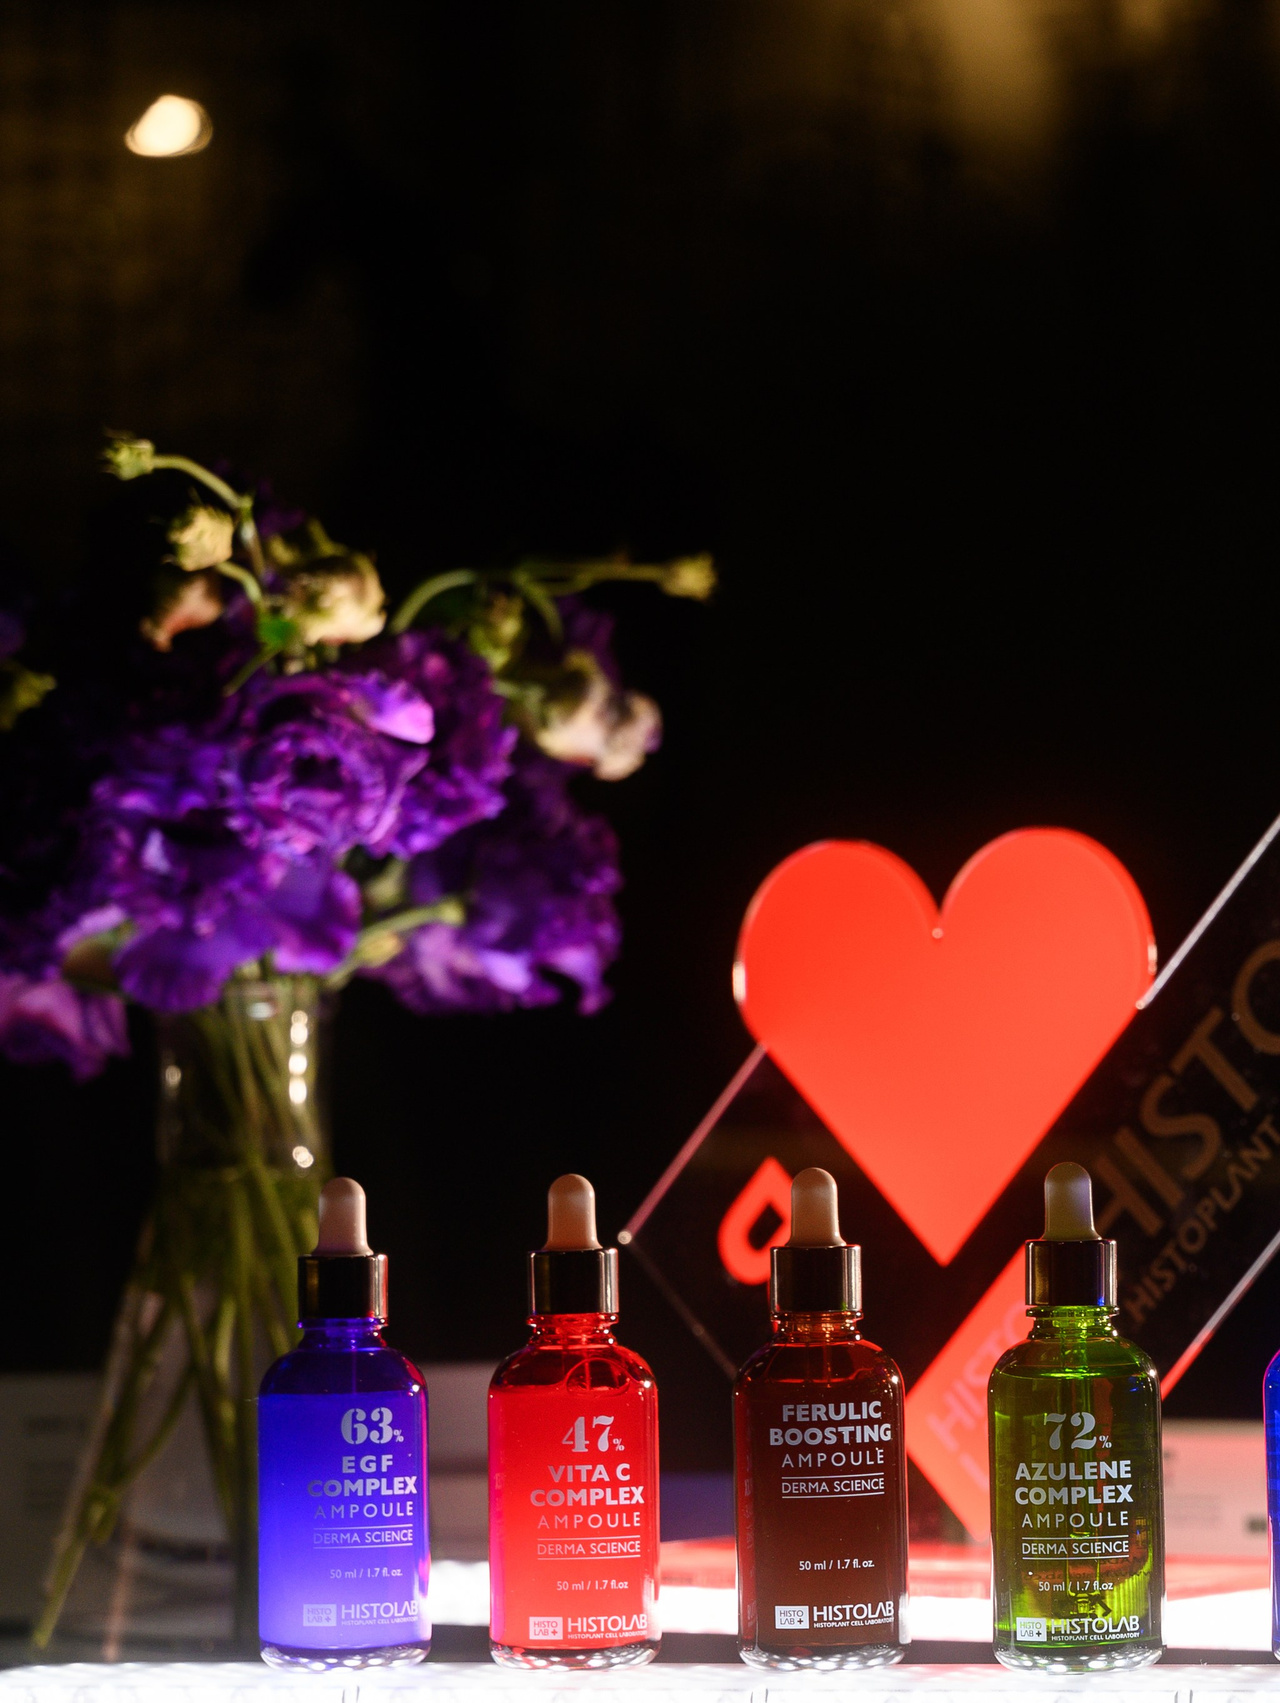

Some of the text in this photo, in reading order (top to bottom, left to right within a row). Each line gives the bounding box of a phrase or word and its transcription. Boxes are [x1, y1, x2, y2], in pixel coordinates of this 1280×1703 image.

[782, 1401, 882, 1422] FERULIC
[341, 1407, 404, 1444] 63%
[561, 1415, 625, 1452] 47%
[769, 1423, 891, 1446] BOOSTING
[1043, 1411, 1112, 1450] 72%
[342, 1454, 393, 1473] EGF
[781, 1449, 884, 1468] AMPOULE
[548, 1463, 631, 1483] VITA C
[1015, 1460, 1131, 1481] AZULENE
[308, 1476, 417, 1497] COMPLEX
[782, 1478, 885, 1494] DERMA SCIENCE
[1015, 1484, 1133, 1505] COMPLEX
[530, 1486, 644, 1507] COMPLEX
[314, 1501, 413, 1519] AMPOULE
[1022, 1511, 1129, 1528] AMPOULE
[537, 1511, 641, 1529] AMPOULE
[313, 1529, 413, 1544] DERMA SCIENCE
[537, 1540, 641, 1555] DERMA SCIENCE
[1022, 1540, 1129, 1555] DERMA SCIENCE
[330, 1569, 342, 1579] 50
[344, 1568, 357, 1578] ml
[367, 1567, 380, 1578] 1.7
[799, 1560, 811, 1570] 50
[814, 1560, 826, 1570] ml
[837, 1559, 850, 1569] 1.7
[556, 1581, 569, 1591] 50
[572, 1581, 584, 1590] ml
[595, 1580, 608, 1590] 1.7
[1038, 1581, 1050, 1591] 50
[1053, 1581, 1065, 1591] ml
[1076, 1581, 1090, 1591] 1.7
[341, 1600, 418, 1619] HISTOLAB
[813, 1601, 894, 1621] HISTOLAB
[568, 1614, 647, 1632] HISTOLAB
[1020, 1621, 1042, 1629] HISTO
[1051, 1615, 1140, 1634] HISTOLAB
